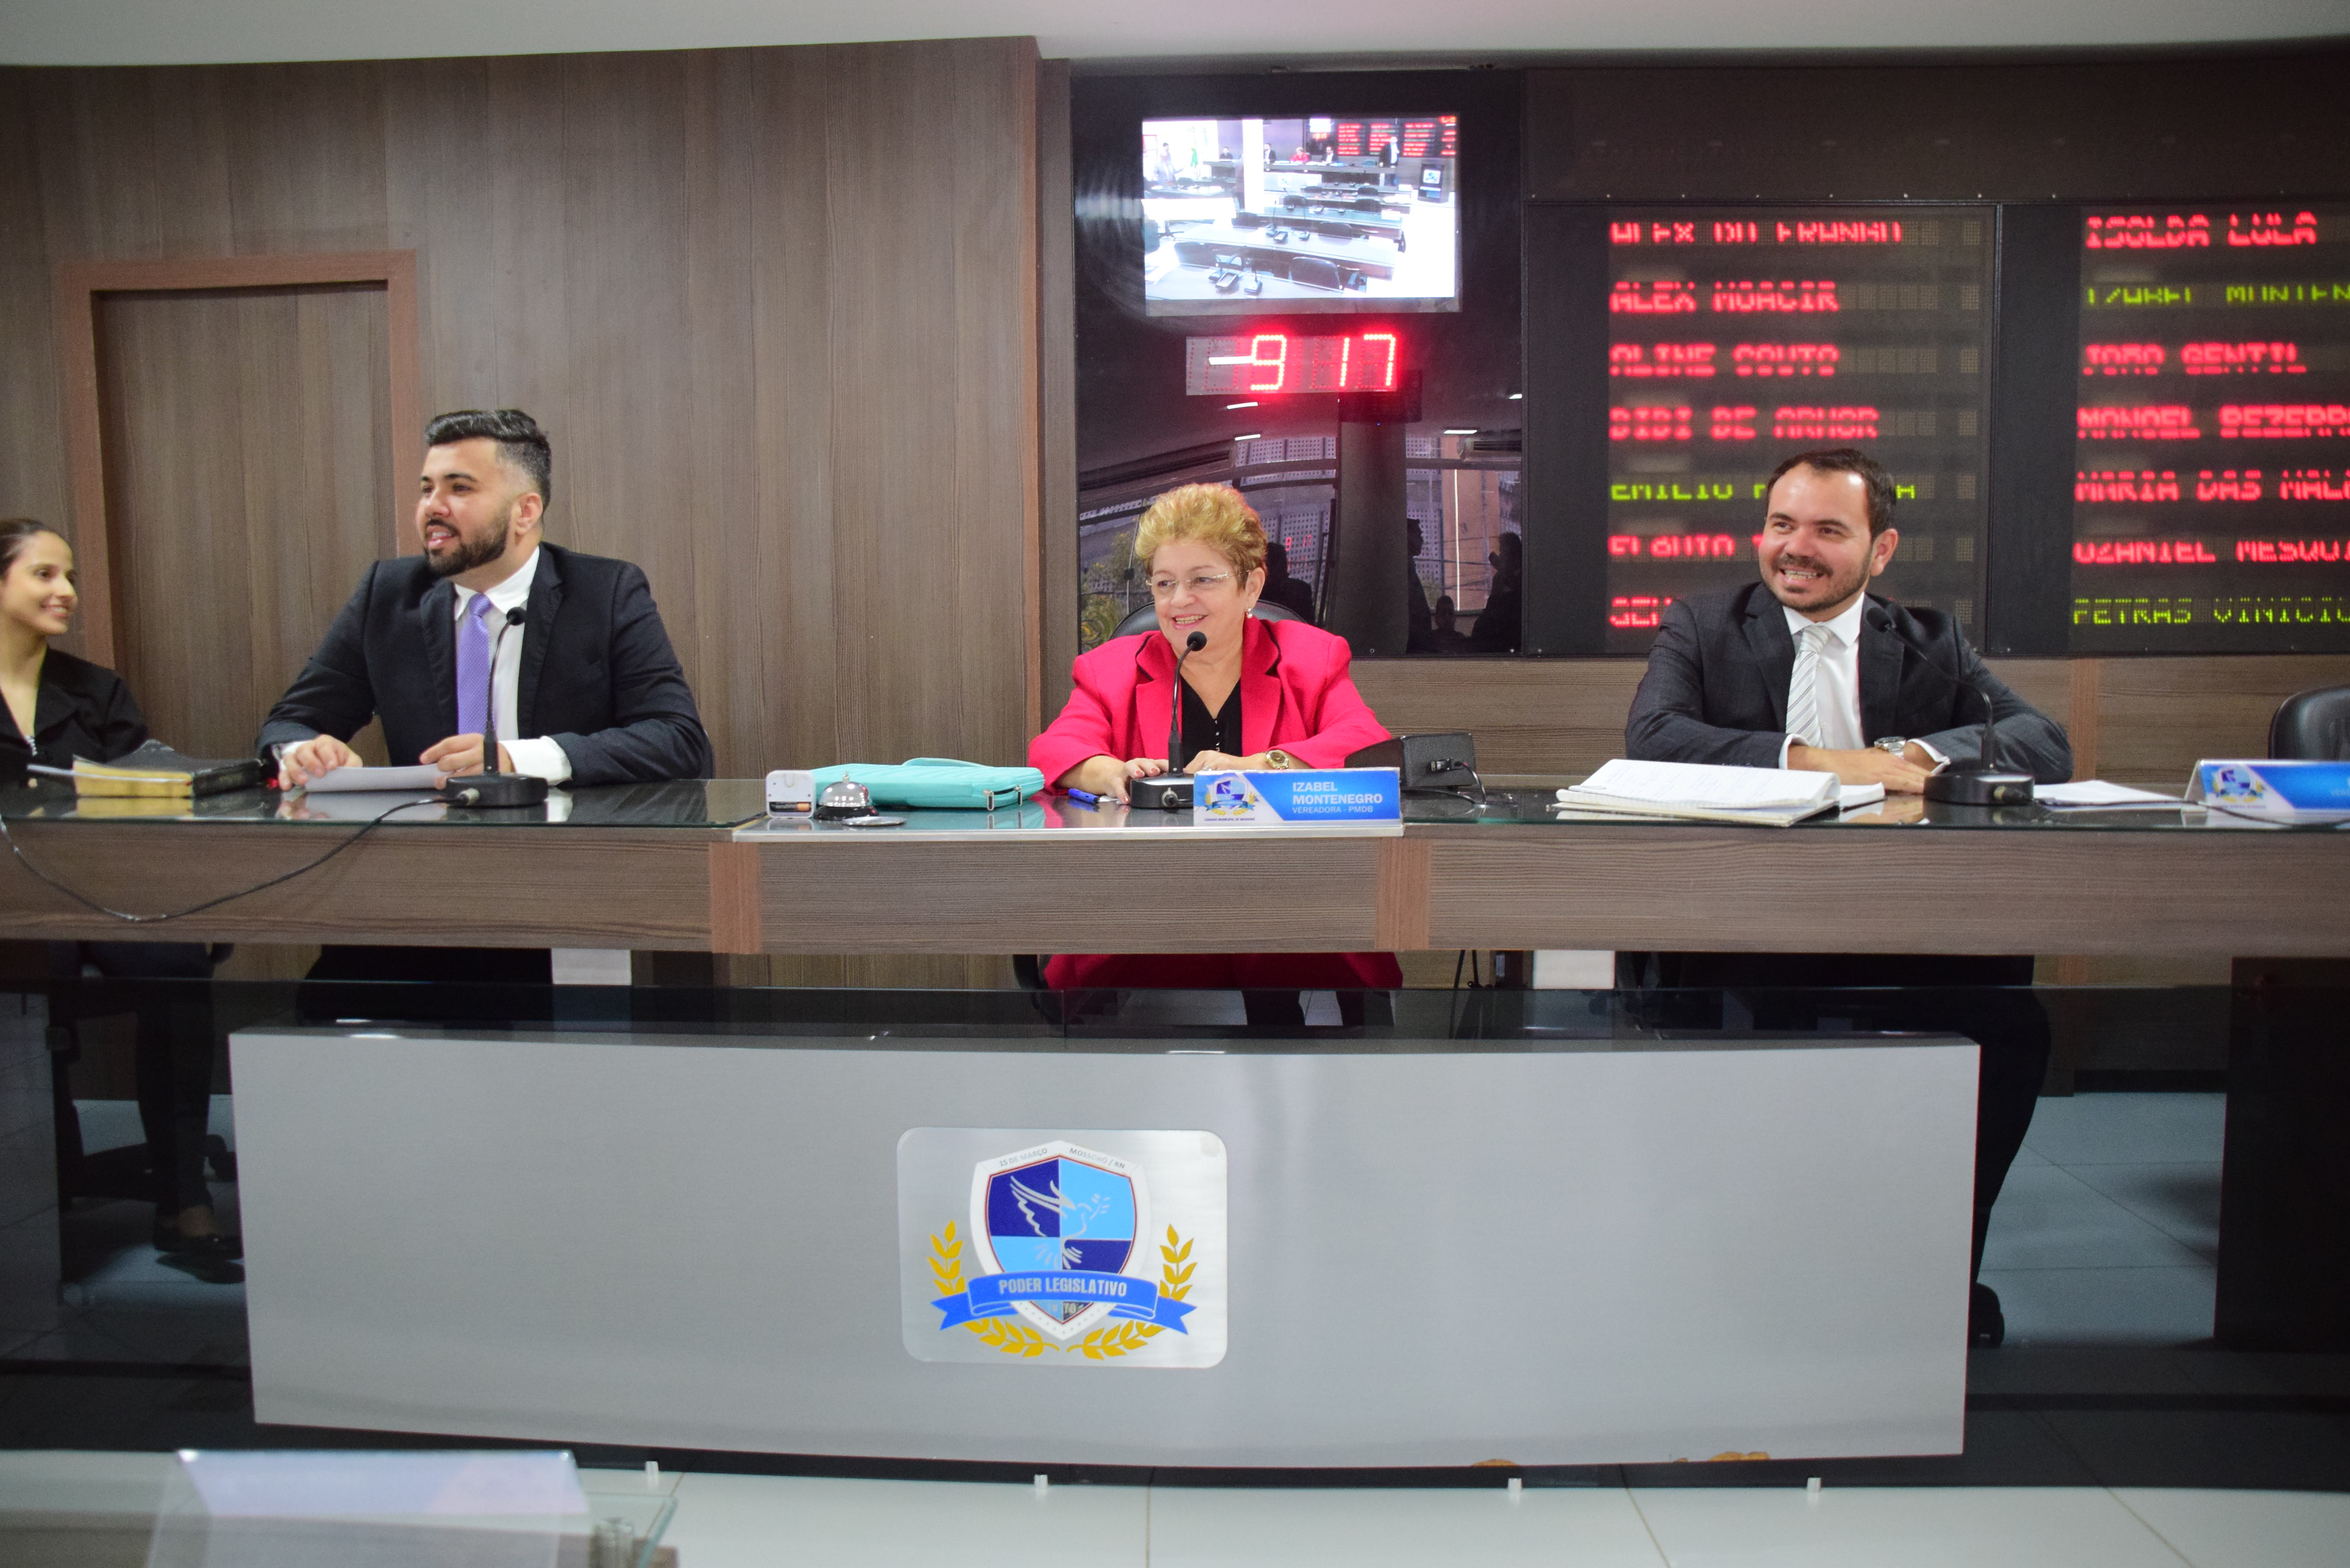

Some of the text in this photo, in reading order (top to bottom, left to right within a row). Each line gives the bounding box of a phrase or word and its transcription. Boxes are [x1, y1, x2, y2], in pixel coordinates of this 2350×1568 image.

[1609, 281, 1697, 314] ALEX
[2073, 598, 2192, 625] PETRAS
[1293, 781, 1338, 792] IZABEL
[1293, 793, 1383, 805] MONTENEGRO
[999, 1277, 1127, 1297] PODER LEGISLATIVO
